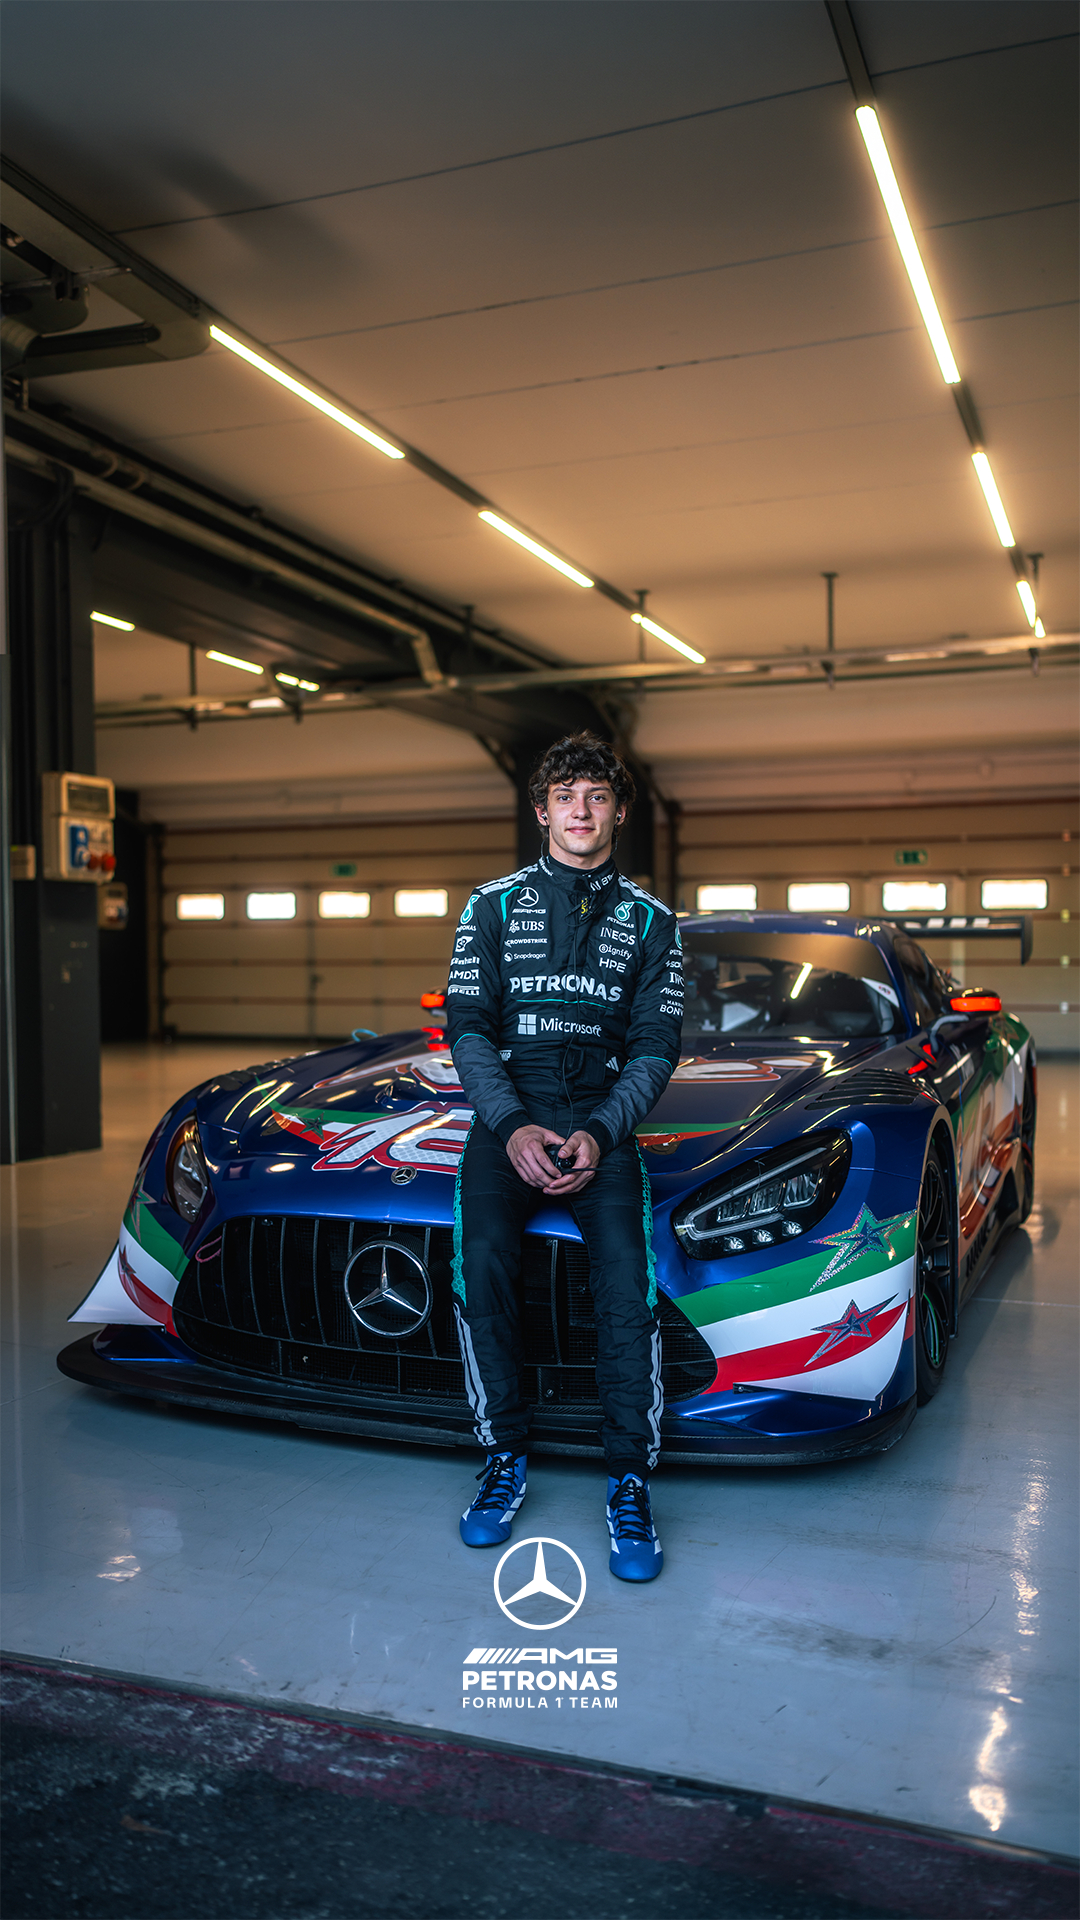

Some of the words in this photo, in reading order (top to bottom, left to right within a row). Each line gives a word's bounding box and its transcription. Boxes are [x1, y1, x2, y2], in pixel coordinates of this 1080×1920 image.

[521, 921, 545, 931] UBS
[607, 917, 634, 929] PETRONAS
[600, 927, 636, 946] INEOS
[599, 957, 627, 973] HPE
[449, 970, 471, 981] AMD
[509, 974, 623, 1002] PETRONAS
[540, 1018, 602, 1037] Microsoft
